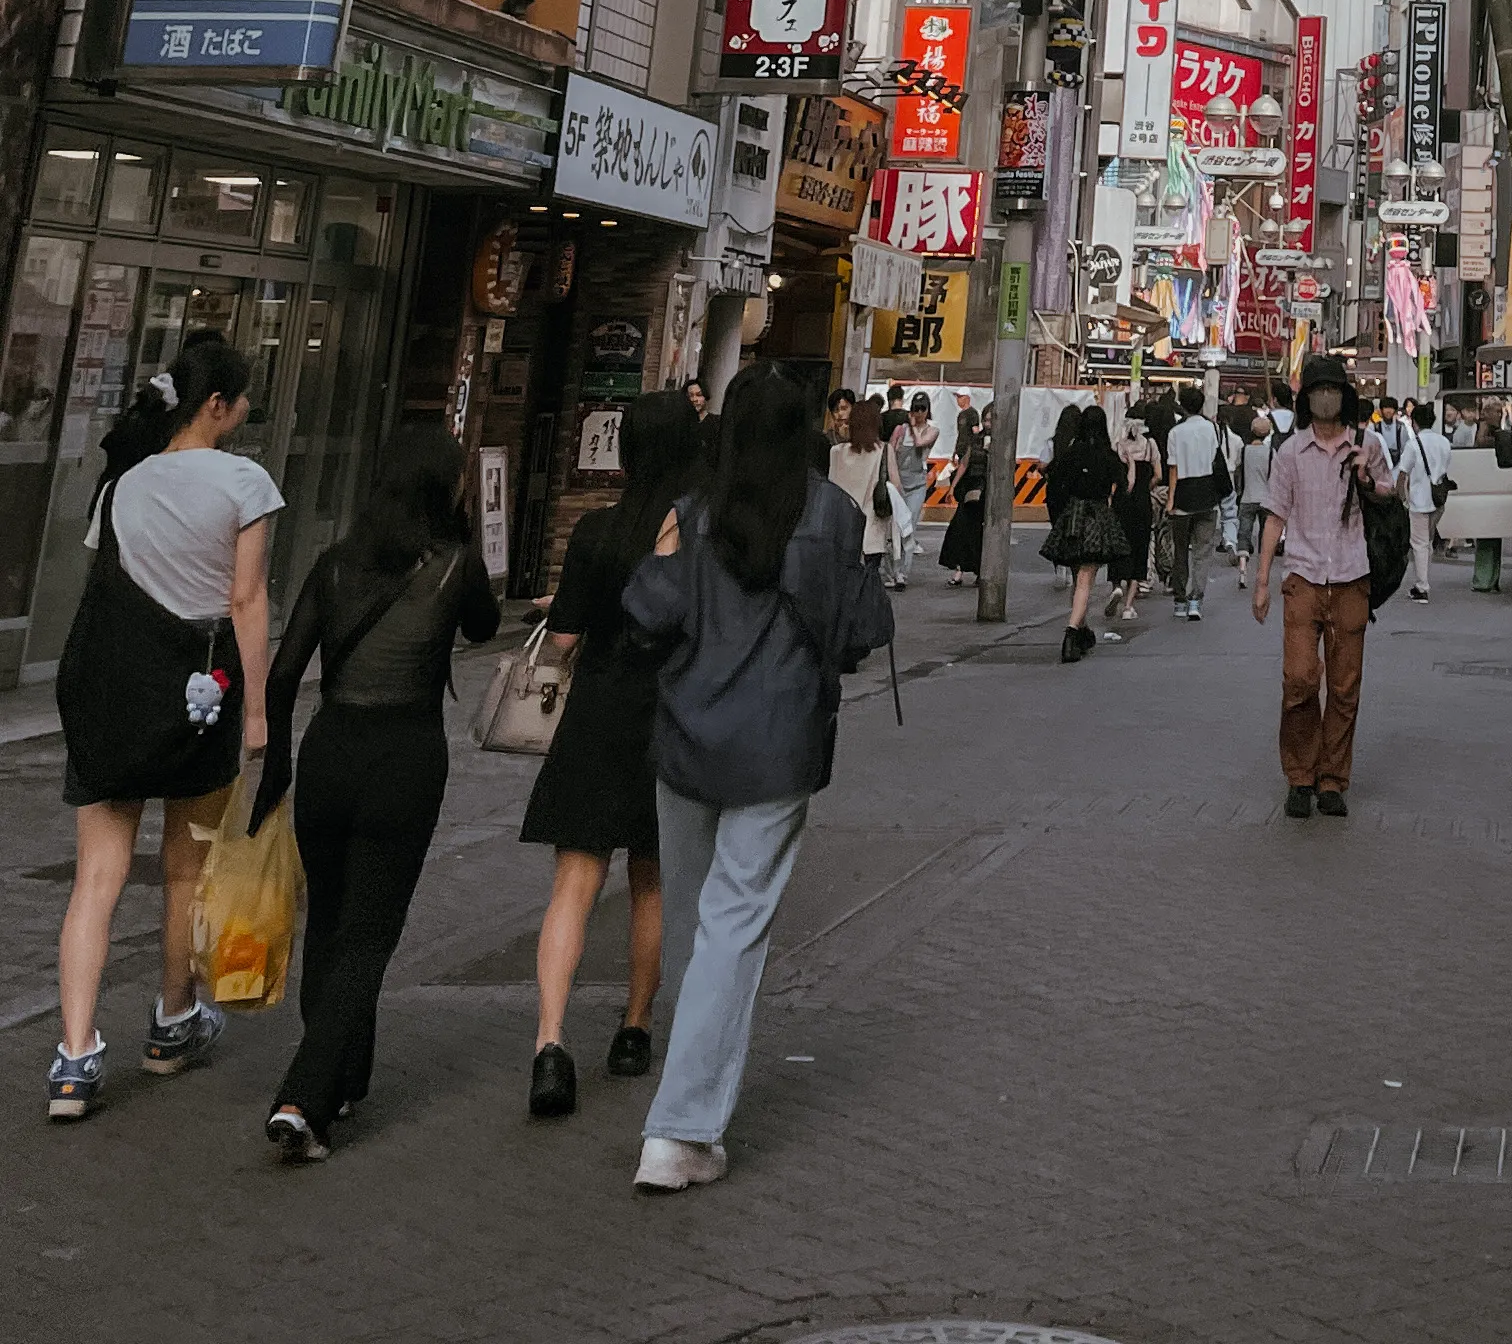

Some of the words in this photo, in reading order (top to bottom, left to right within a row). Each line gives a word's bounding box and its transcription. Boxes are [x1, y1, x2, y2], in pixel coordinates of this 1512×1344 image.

[161, 25, 189, 61] 酒
[200, 27, 263, 58] たばこ
[1174, 50, 1245, 98] ラオケ
[916, 46, 947, 124] 楊福
[1297, 65, 1313, 107] ECHO
[565, 111, 589, 157] 5F
[591, 105, 684, 192] 築地もんじゃ
[1293, 121, 1315, 222] カラオ
[888, 172, 971, 250] 豚
